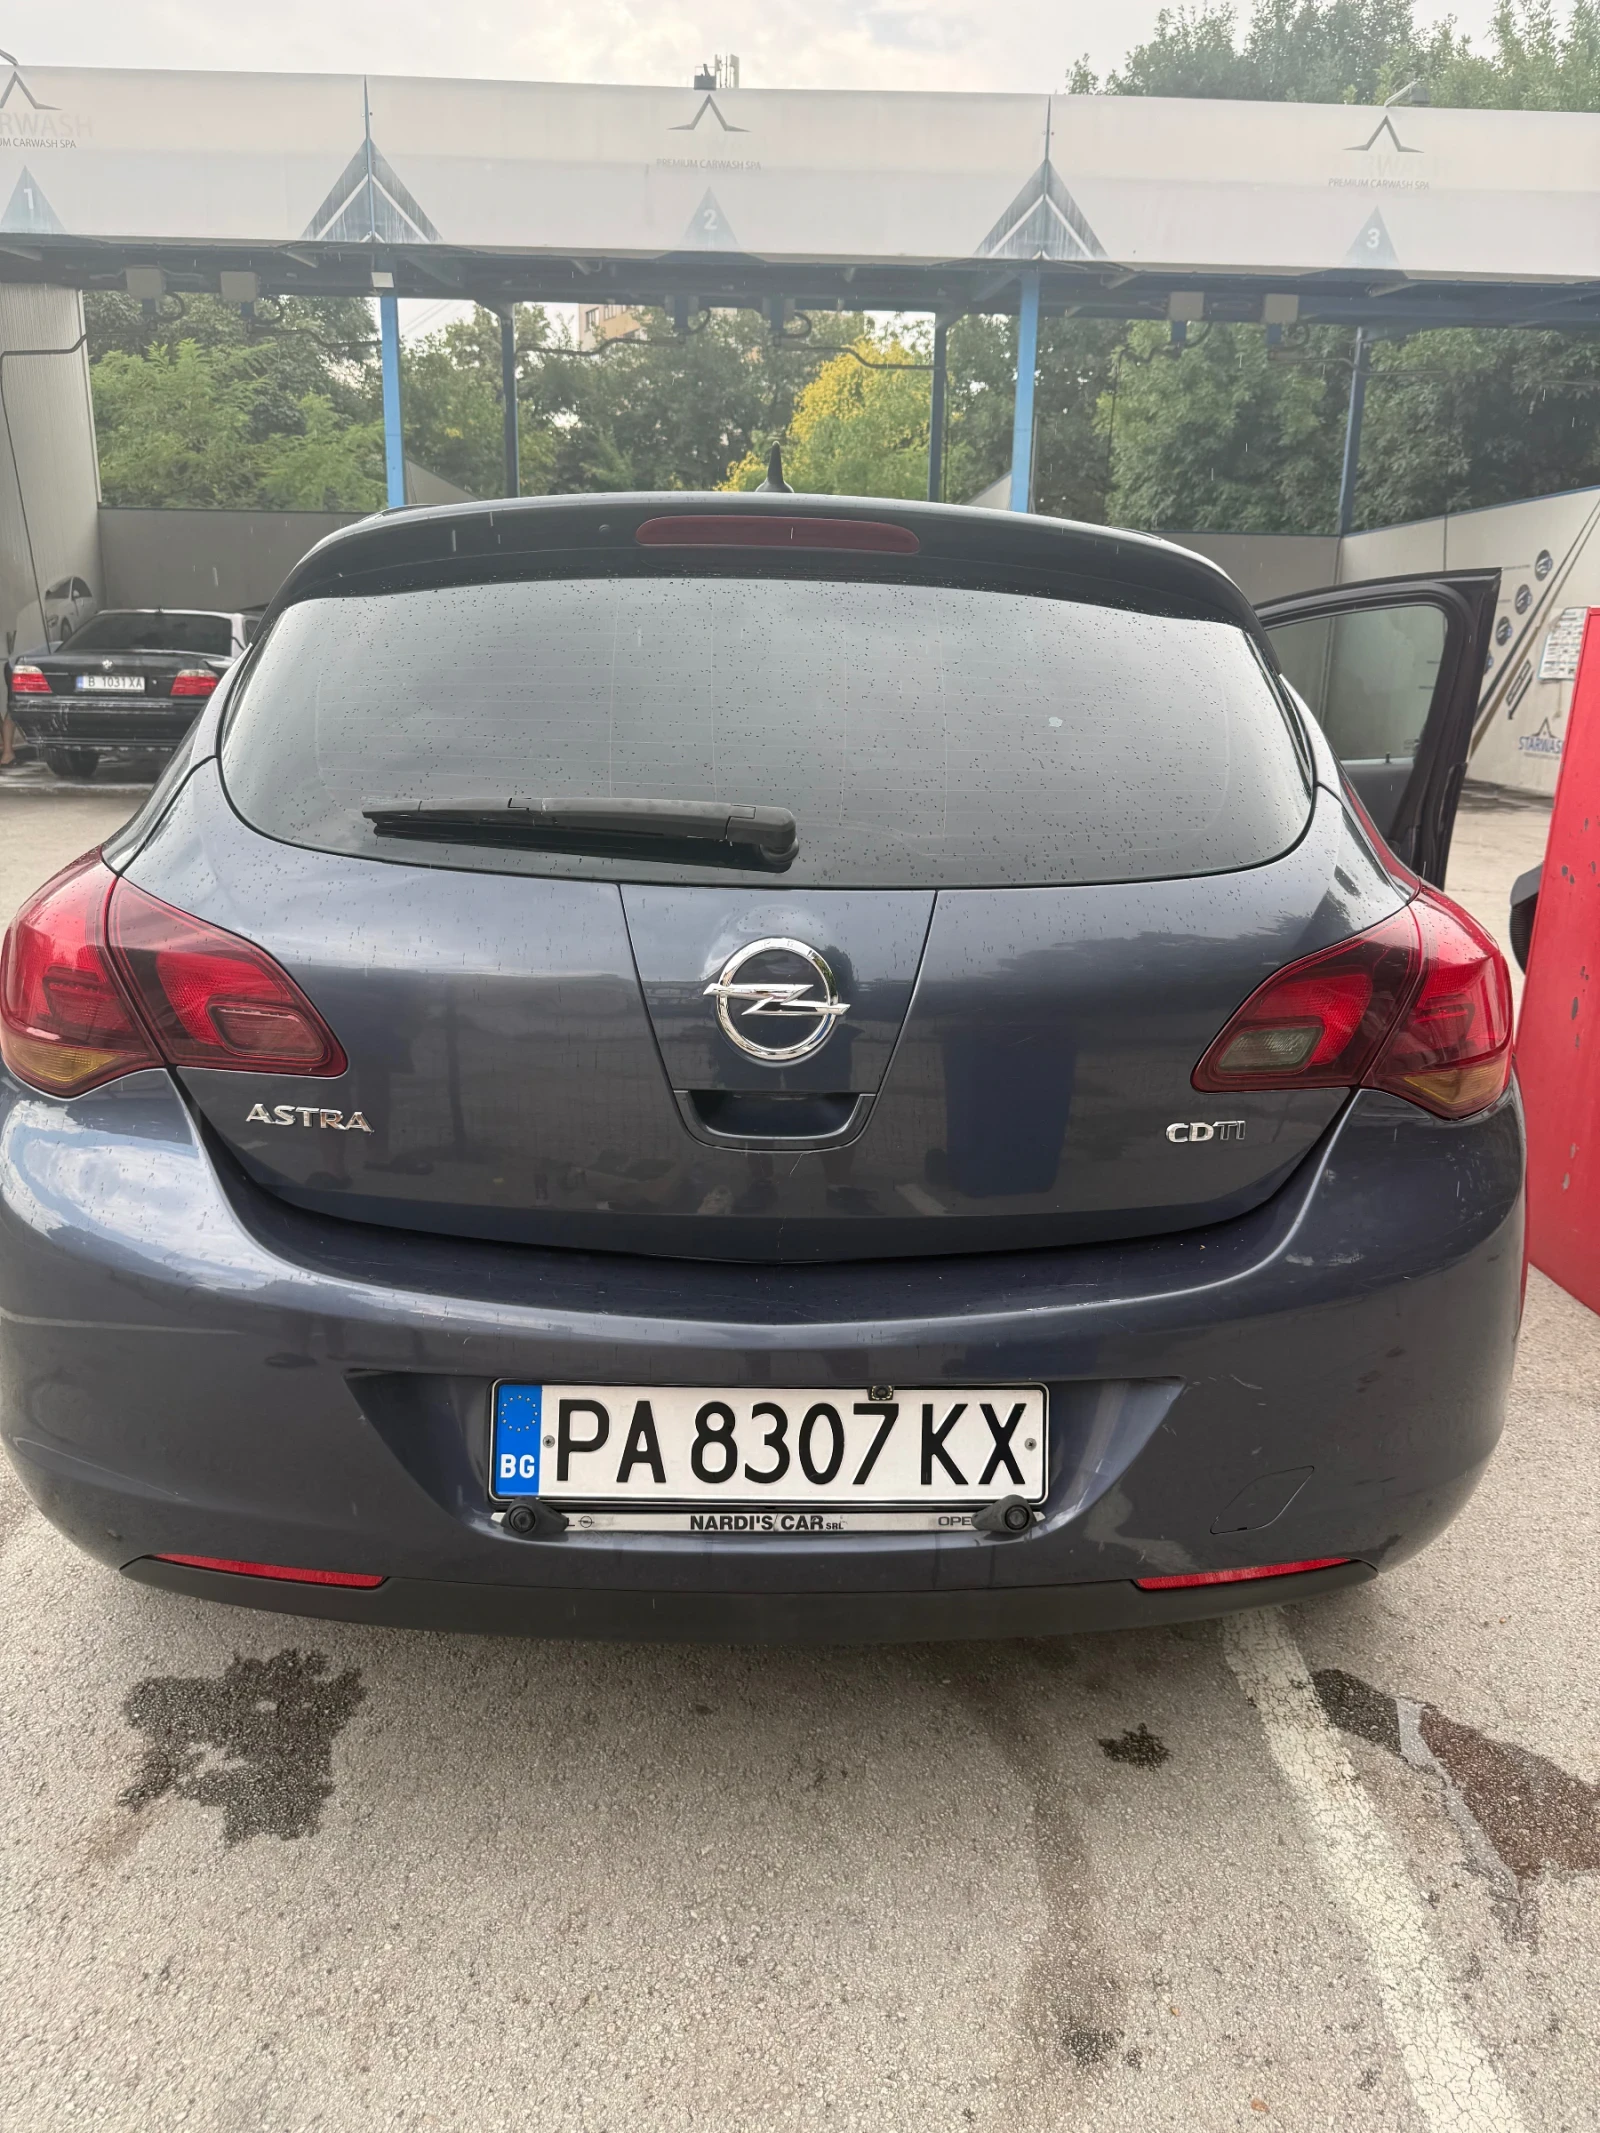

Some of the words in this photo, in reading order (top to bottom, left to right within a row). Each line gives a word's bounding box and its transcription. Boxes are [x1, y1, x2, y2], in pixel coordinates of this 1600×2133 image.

[13, 137, 58, 148] CARWASH
[60, 139, 77, 149] SPA
[656, 158, 698, 169] PREMIUM
[700, 159, 744, 170] CARWASH
[745, 160, 761, 171] SPA
[1328, 178, 1368, 188] PREMIUM
[1370, 179, 1413, 190] CARWASH
[1414, 180, 1430, 191] SPA
[24, 188, 34, 209] 1
[703, 209, 718, 230] 2
[1366, 228, 1381, 249] 3
[88, 676, 96, 687] B
[129, 676, 143, 688] XA
[1518, 736, 1563, 754] STARWAS
[246, 1103, 374, 1133] ASTRA
[1165, 1120, 1247, 1143] CDTI
[556, 1398, 667, 1484] PA
[690, 1400, 900, 1486] 8307
[920, 1402, 1028, 1486] KX
[500, 1453, 536, 1479] BG
[690, 1515, 774, 1531] NARDI'S
[781, 1515, 824, 1531] CAR
[826, 1521, 845, 1530] SRL
[938, 1516, 973, 1527] OPE
